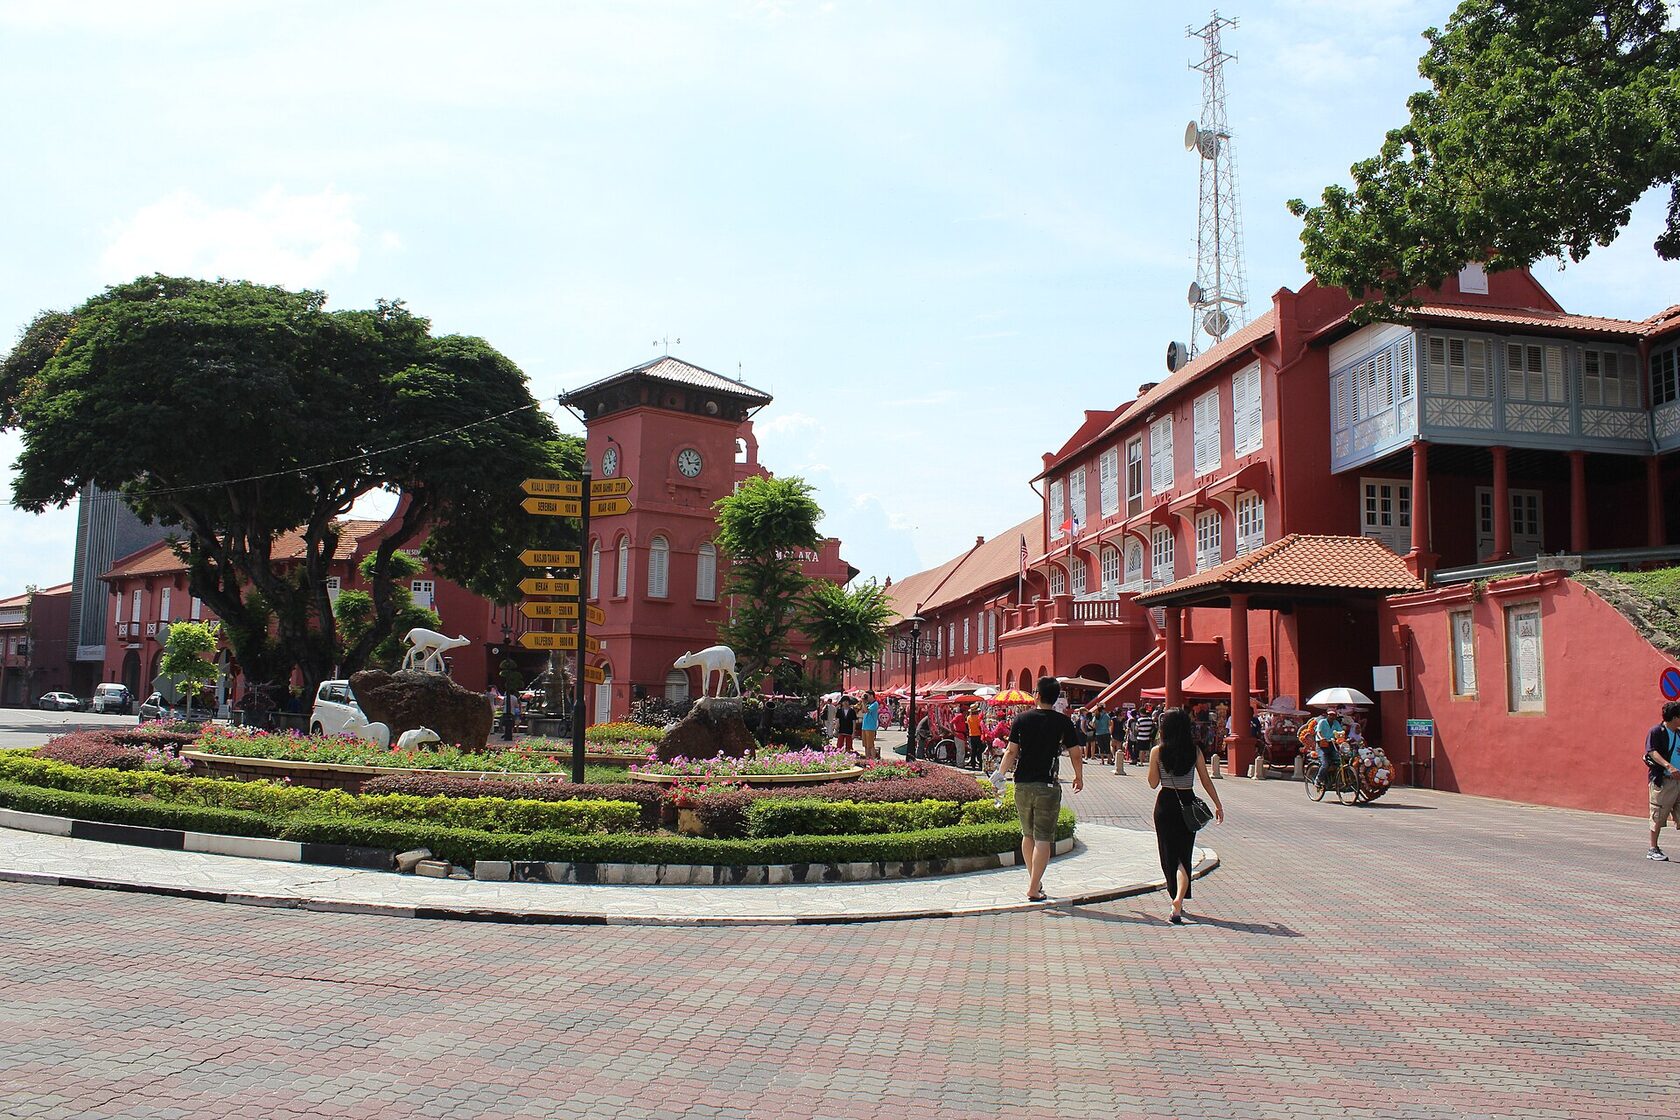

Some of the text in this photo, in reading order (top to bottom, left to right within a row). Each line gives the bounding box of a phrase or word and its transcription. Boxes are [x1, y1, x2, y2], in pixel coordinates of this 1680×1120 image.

[532, 482, 544, 491] KUALA
[544, 483, 560, 492] LUMPUR
[538, 502, 557, 512] SEREMBAN
[547, 554, 560, 563] TANAH
[536, 582, 548, 591] MEKAH
